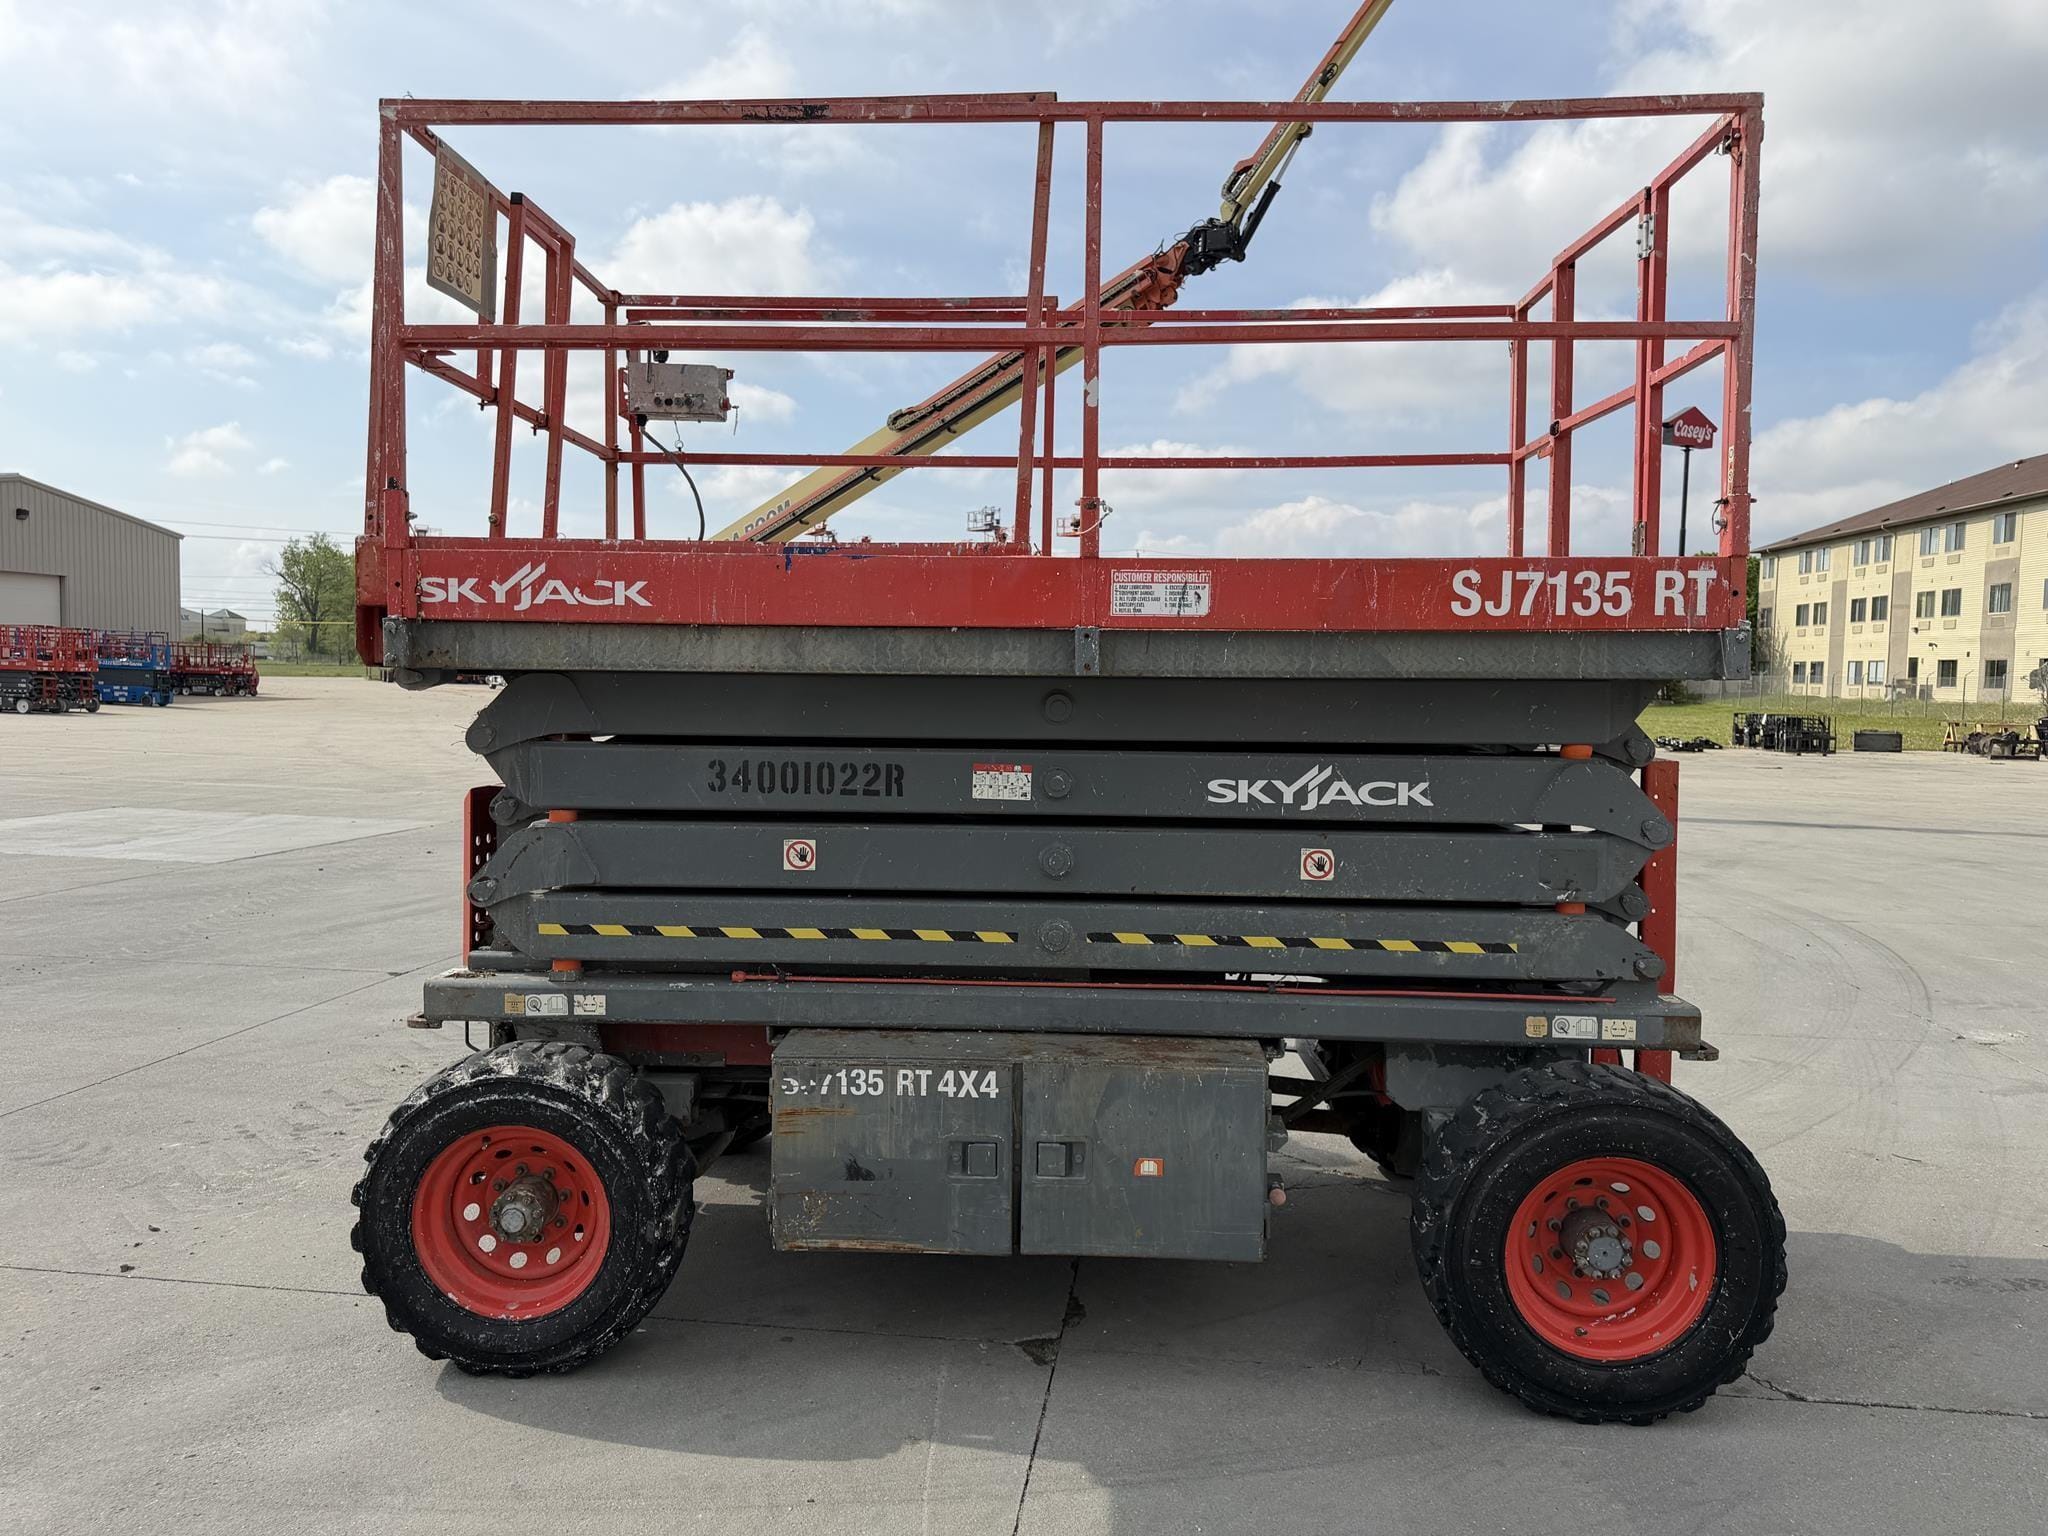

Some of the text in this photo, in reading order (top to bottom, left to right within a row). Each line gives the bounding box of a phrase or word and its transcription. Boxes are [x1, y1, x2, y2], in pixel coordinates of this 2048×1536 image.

[1674, 420, 1712, 443] Casey's
[420, 562, 653, 611] SKYJACK
[1113, 572, 1210, 583] CUSTOMER RESPONSIBILITY
[1450, 569, 1717, 617] SJ7135 RT
[707, 759, 905, 797] 34001022R
[1207, 764, 1434, 811] SKYJACK
[781, 1069, 999, 1098] S7135 RT 4X4
